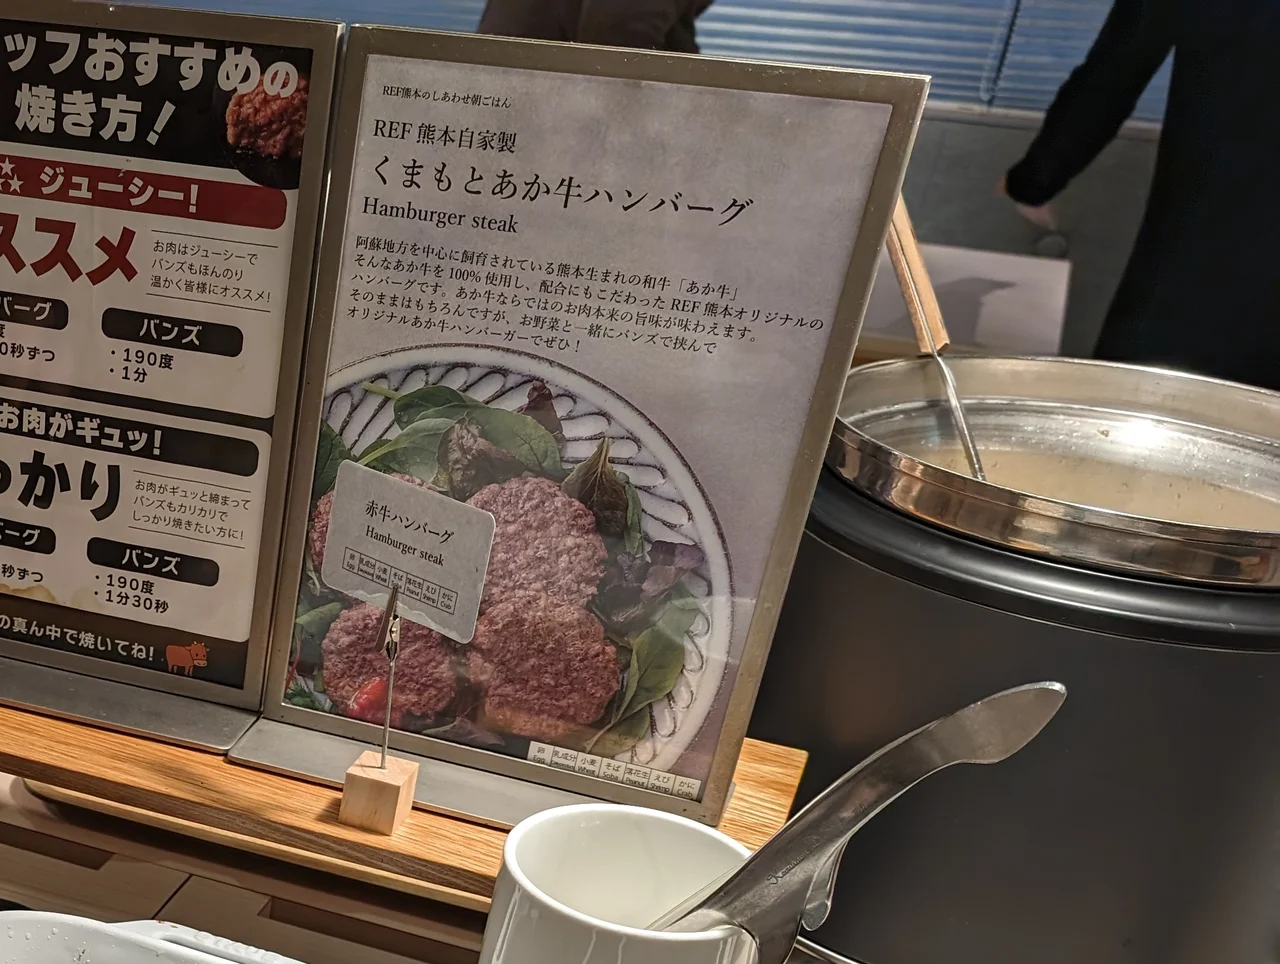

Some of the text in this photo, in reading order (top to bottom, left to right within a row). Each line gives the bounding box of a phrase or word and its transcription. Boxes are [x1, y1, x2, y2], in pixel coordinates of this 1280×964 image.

[382, 84, 512, 109] REF熊本のしあわせ朝ごはん
[14, 83, 176, 146] 焼き方!
[373, 118, 517, 153] REF 熊本自家製
[39, 166, 199, 213] ジューシー!
[374, 155, 754, 227] くまもとあか牛ハンバーグ
[362, 196, 518, 234] Hamburger steak
[153, 240, 258, 265] お肉はジューシーで
[152, 258, 243, 281] バンズもほんのり
[150, 275, 270, 302] 温かく皆様にオススメ!
[354, 254, 824, 331] そんなあか牛を 100% 使用し、配合にもこだわった REF 熊本オリジナルの
[139, 318, 202, 346] バンズ
[347, 306, 580, 353] オリジナルあか牛ハンバーガーでぜひ!
[133, 496, 228, 522] バンズもカリカリで
[134, 479, 251, 511] お肉がギュッと締まって
[132, 512, 244, 541] しっかり焼きたい方に!
[365, 500, 454, 544] 赤牛ハンバーグ
[122, 549, 181, 576] バンズ
[366, 525, 444, 567] Hamburger steak
